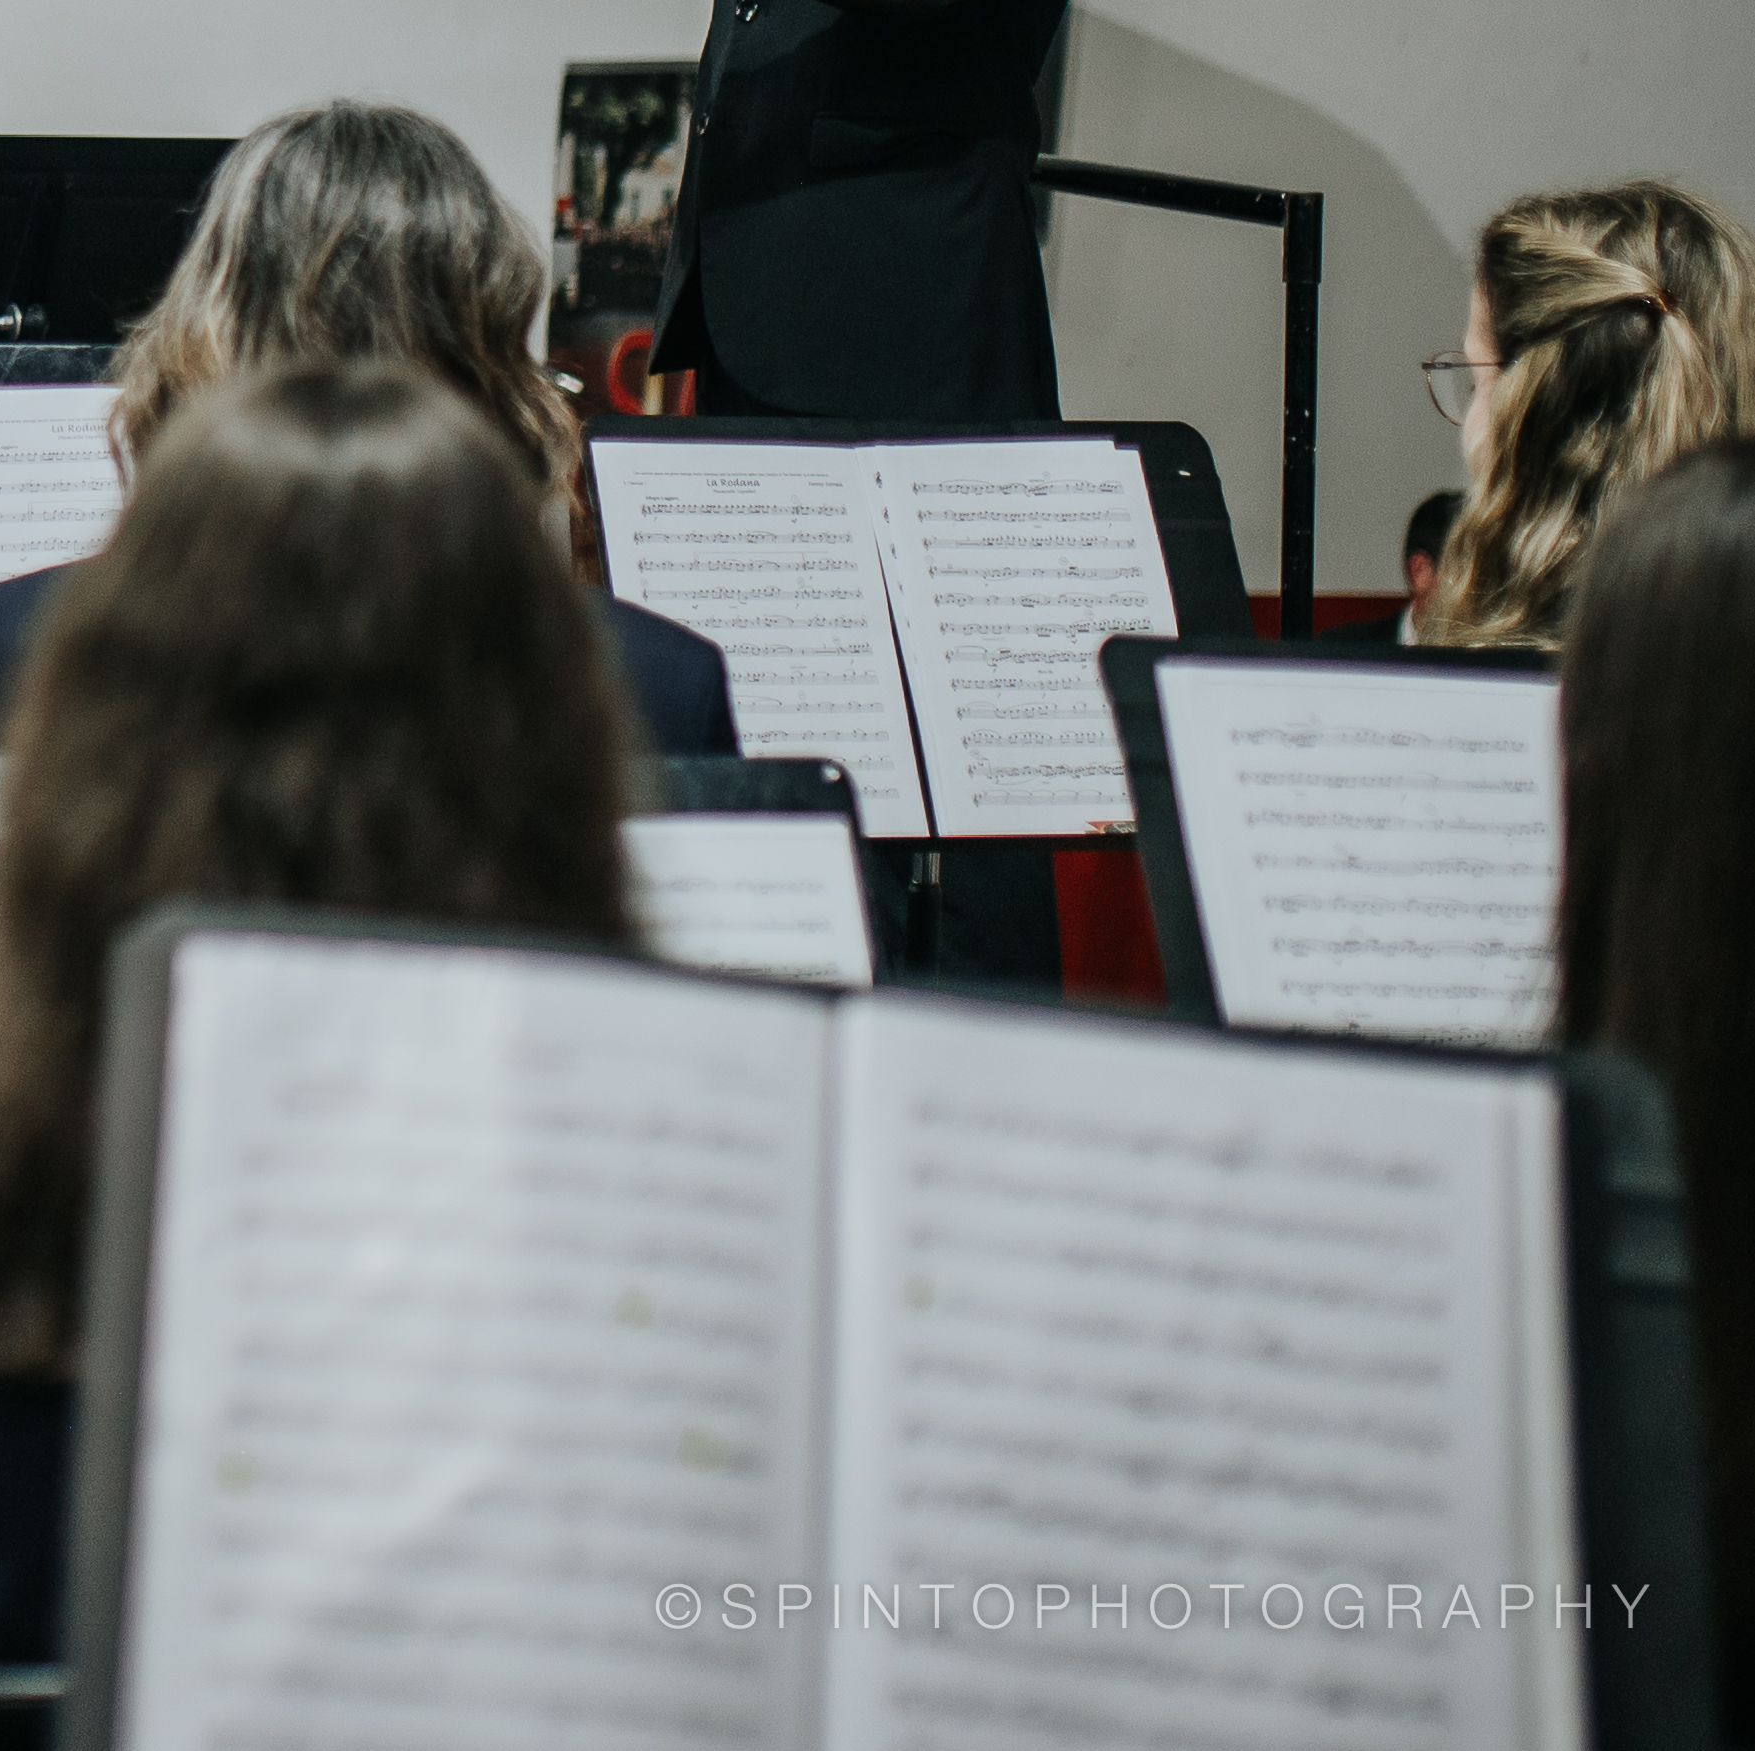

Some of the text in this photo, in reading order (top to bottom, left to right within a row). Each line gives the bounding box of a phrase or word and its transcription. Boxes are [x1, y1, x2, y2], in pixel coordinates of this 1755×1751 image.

[51, 424, 64, 433] La
[706, 478, 761, 487] La Rodana
